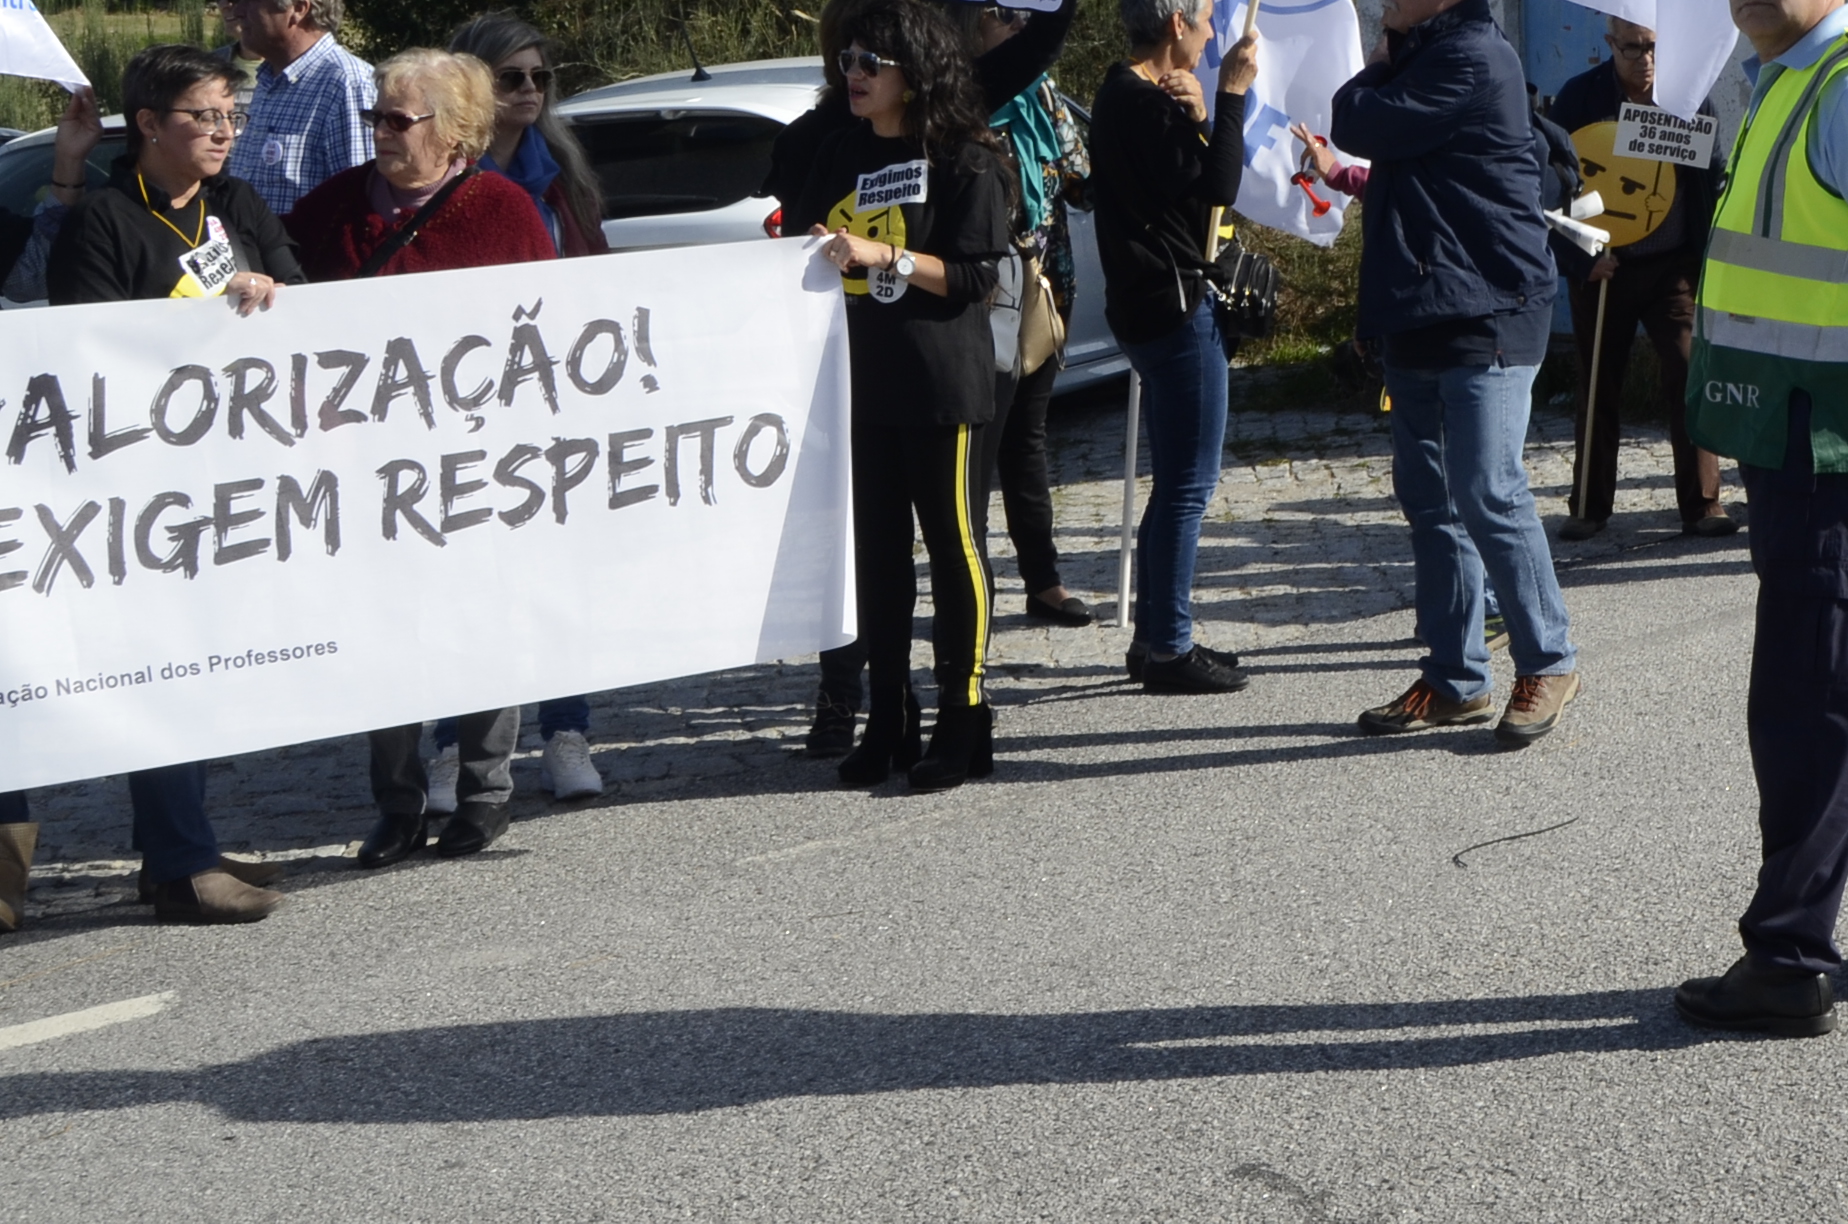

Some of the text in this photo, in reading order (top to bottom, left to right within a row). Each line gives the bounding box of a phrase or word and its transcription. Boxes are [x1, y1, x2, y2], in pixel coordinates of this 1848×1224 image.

[1639, 124, 1692, 146] 36 anos
[1628, 139, 1697, 162] de serviço
[860, 165, 922, 191] Exigimos
[858, 182, 922, 207] Respeito
[876, 271, 896, 286] 4M
[875, 285, 894, 298] 2D
[0, 297, 659, 474] ALORIZAÇÃO!
[1704, 379, 1760, 409] GNR
[375, 413, 791, 548] RESPEITO
[55, 665, 153, 697] Nacional
[159, 661, 202, 681] dos
[207, 639, 339, 673] Professores
